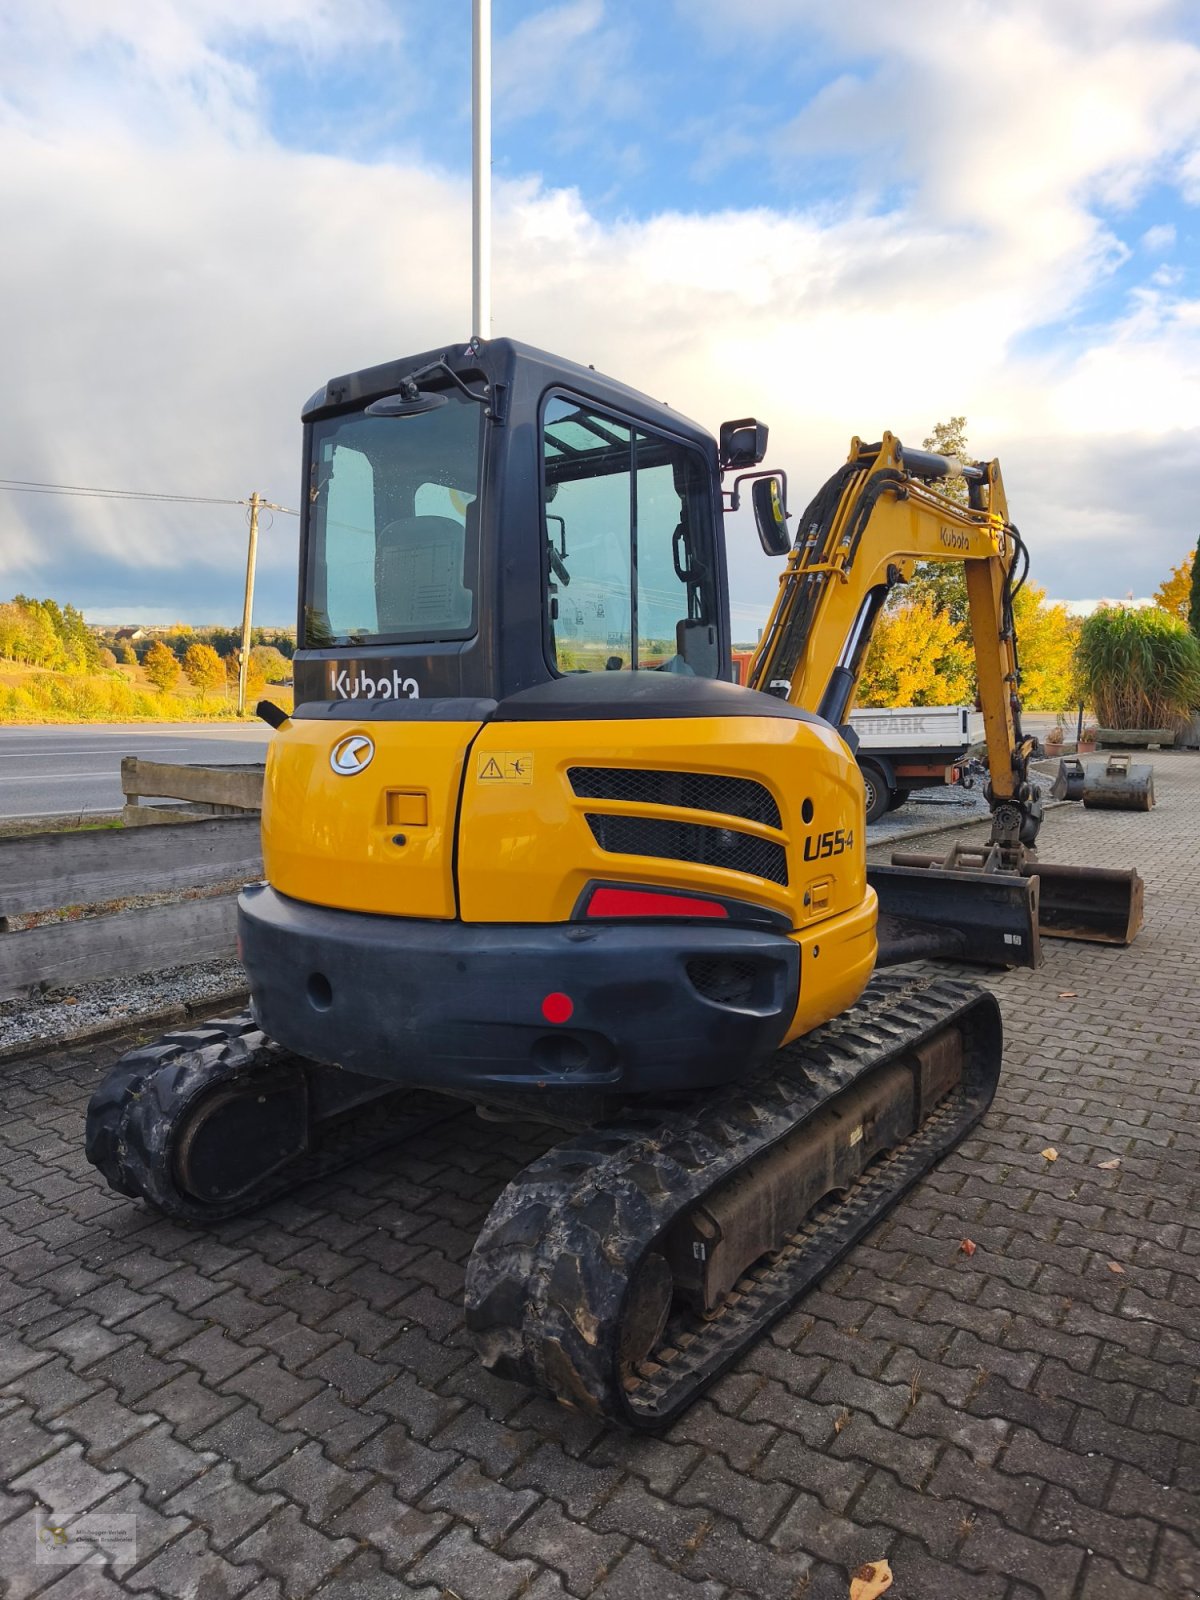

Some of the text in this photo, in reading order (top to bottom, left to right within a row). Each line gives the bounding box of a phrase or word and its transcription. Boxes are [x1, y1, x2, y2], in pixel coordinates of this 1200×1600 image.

[940, 526, 970, 551] Kubota
[330, 669, 419, 699] Kubota
[803, 829, 853, 862] U55-4
